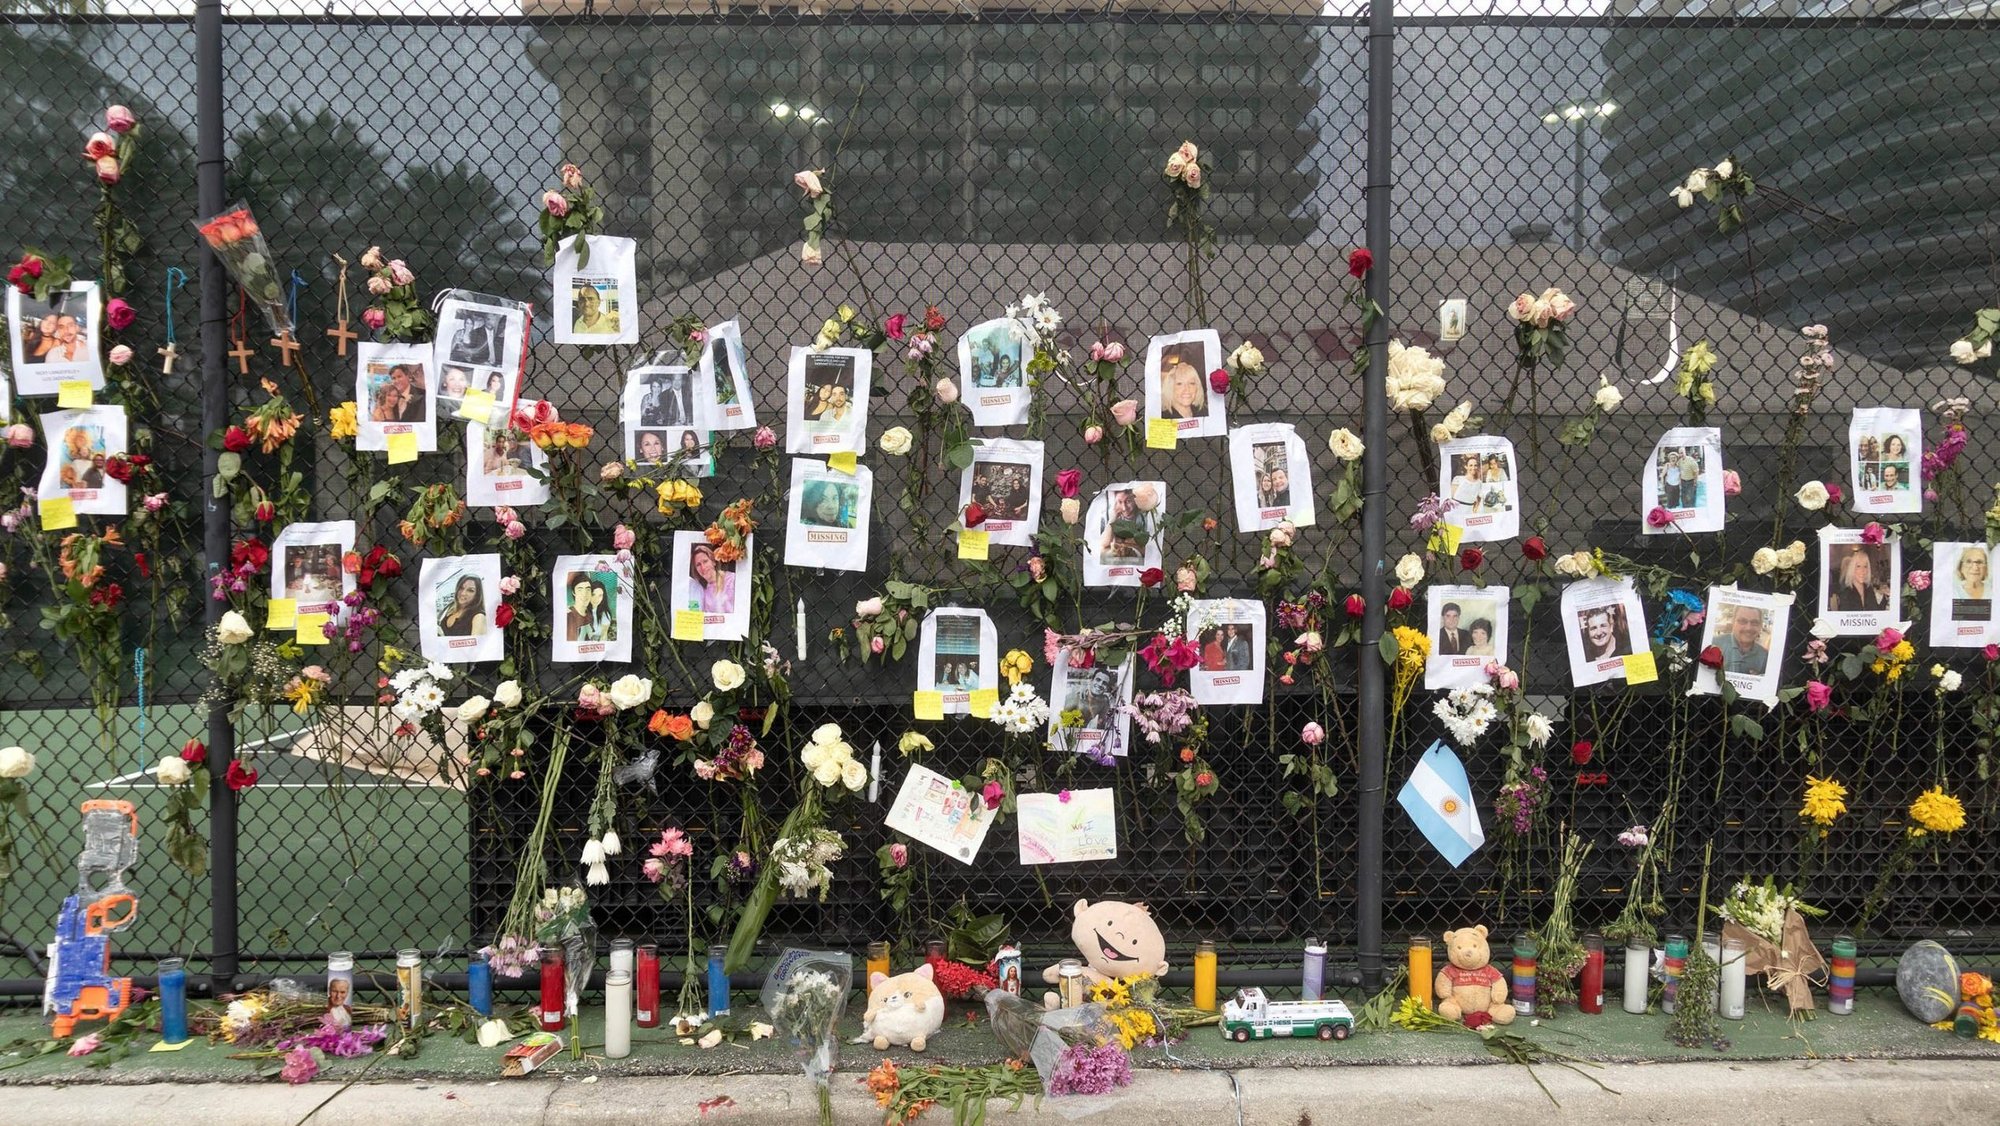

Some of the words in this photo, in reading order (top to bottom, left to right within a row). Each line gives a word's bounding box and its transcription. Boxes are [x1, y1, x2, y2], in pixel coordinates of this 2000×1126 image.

[983, 396, 1009, 405] MISSING
[1468, 516, 1490, 525] MISSING
[987, 523, 1010, 531] MISSING
[810, 532, 846, 541] MISSING
[1840, 619, 1877, 627] MISSING
[451, 639, 476, 647] MISSING
[1215, 677, 1238, 685] MISSING
